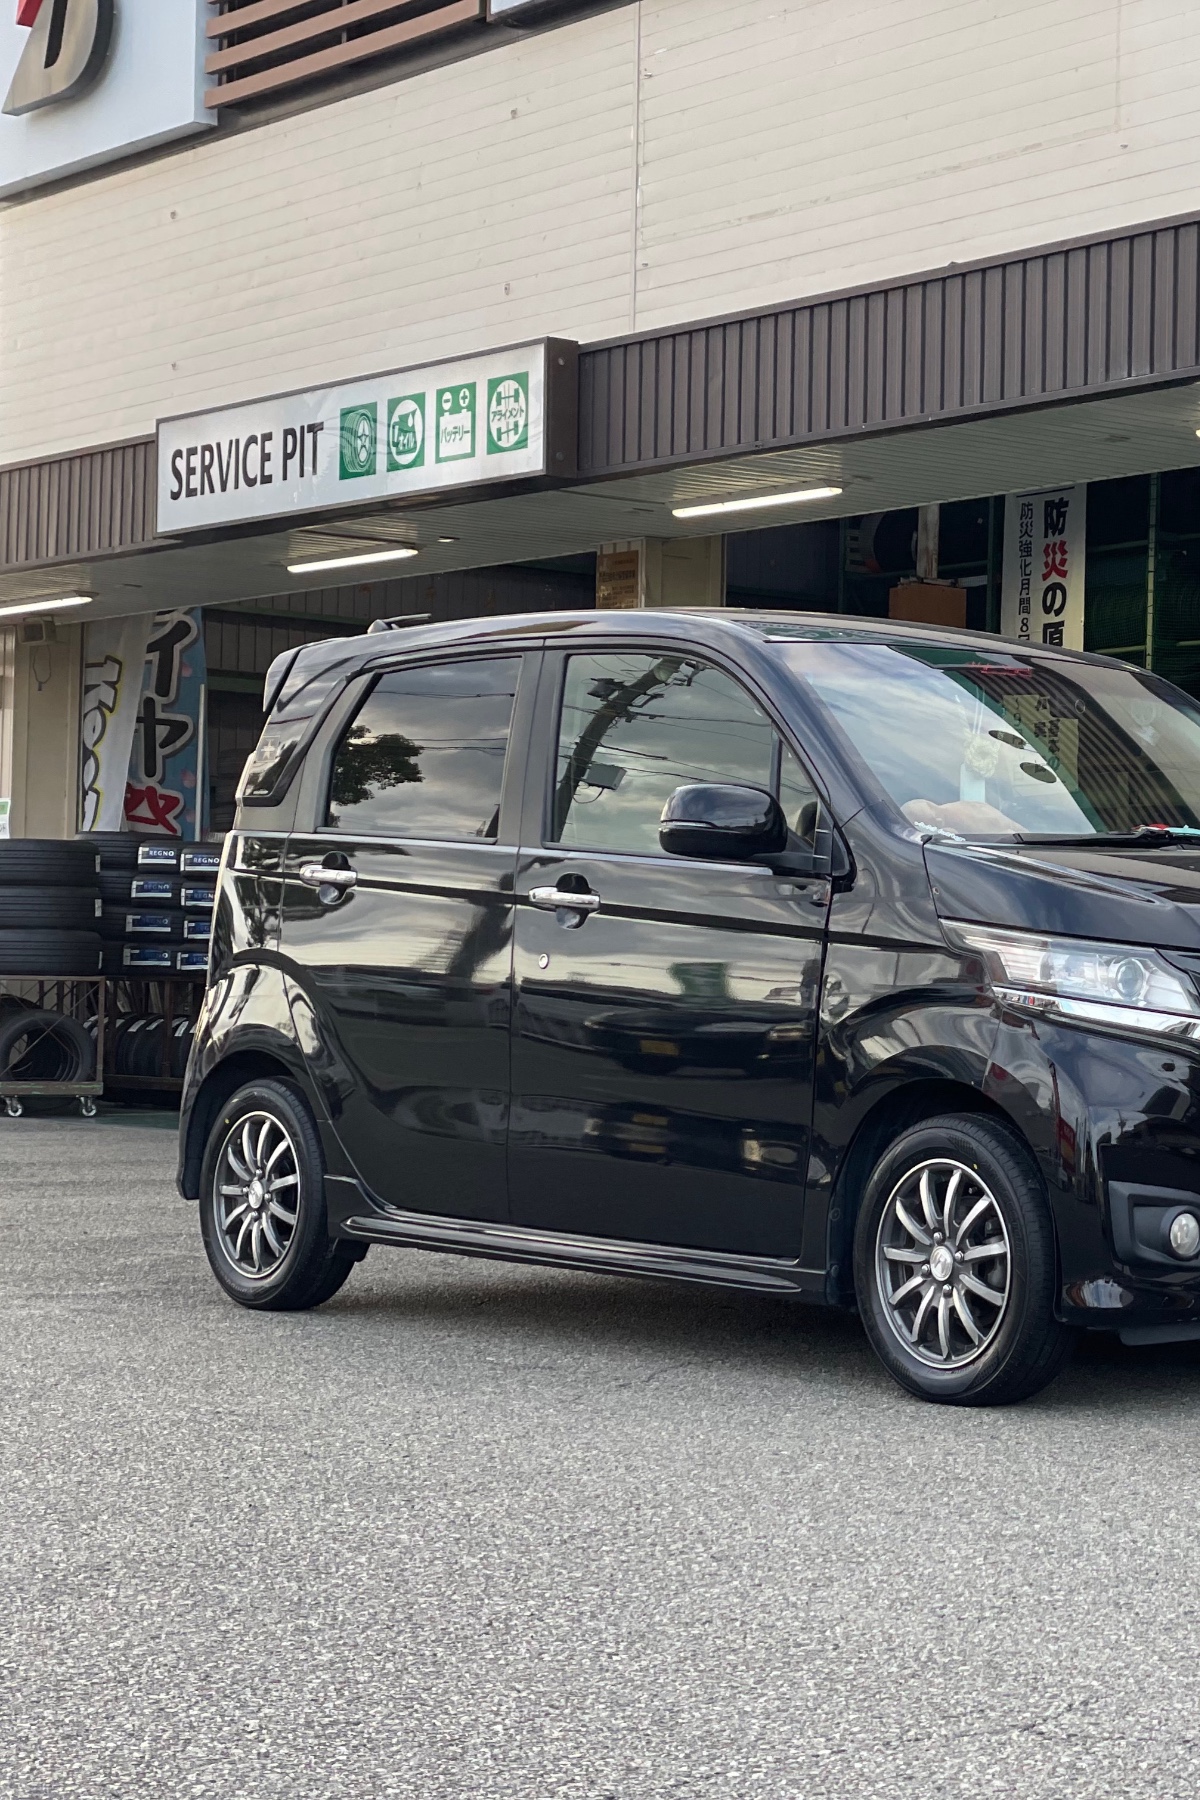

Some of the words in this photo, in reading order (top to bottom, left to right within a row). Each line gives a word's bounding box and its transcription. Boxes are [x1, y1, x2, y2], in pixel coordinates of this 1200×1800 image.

[440, 424, 471, 444] バッテリー
[491, 405, 525, 423] アライメント
[170, 431, 273, 500] SERVICE
[282, 421, 325, 481] PIT
[1041, 496, 1070, 647] 防災の原
